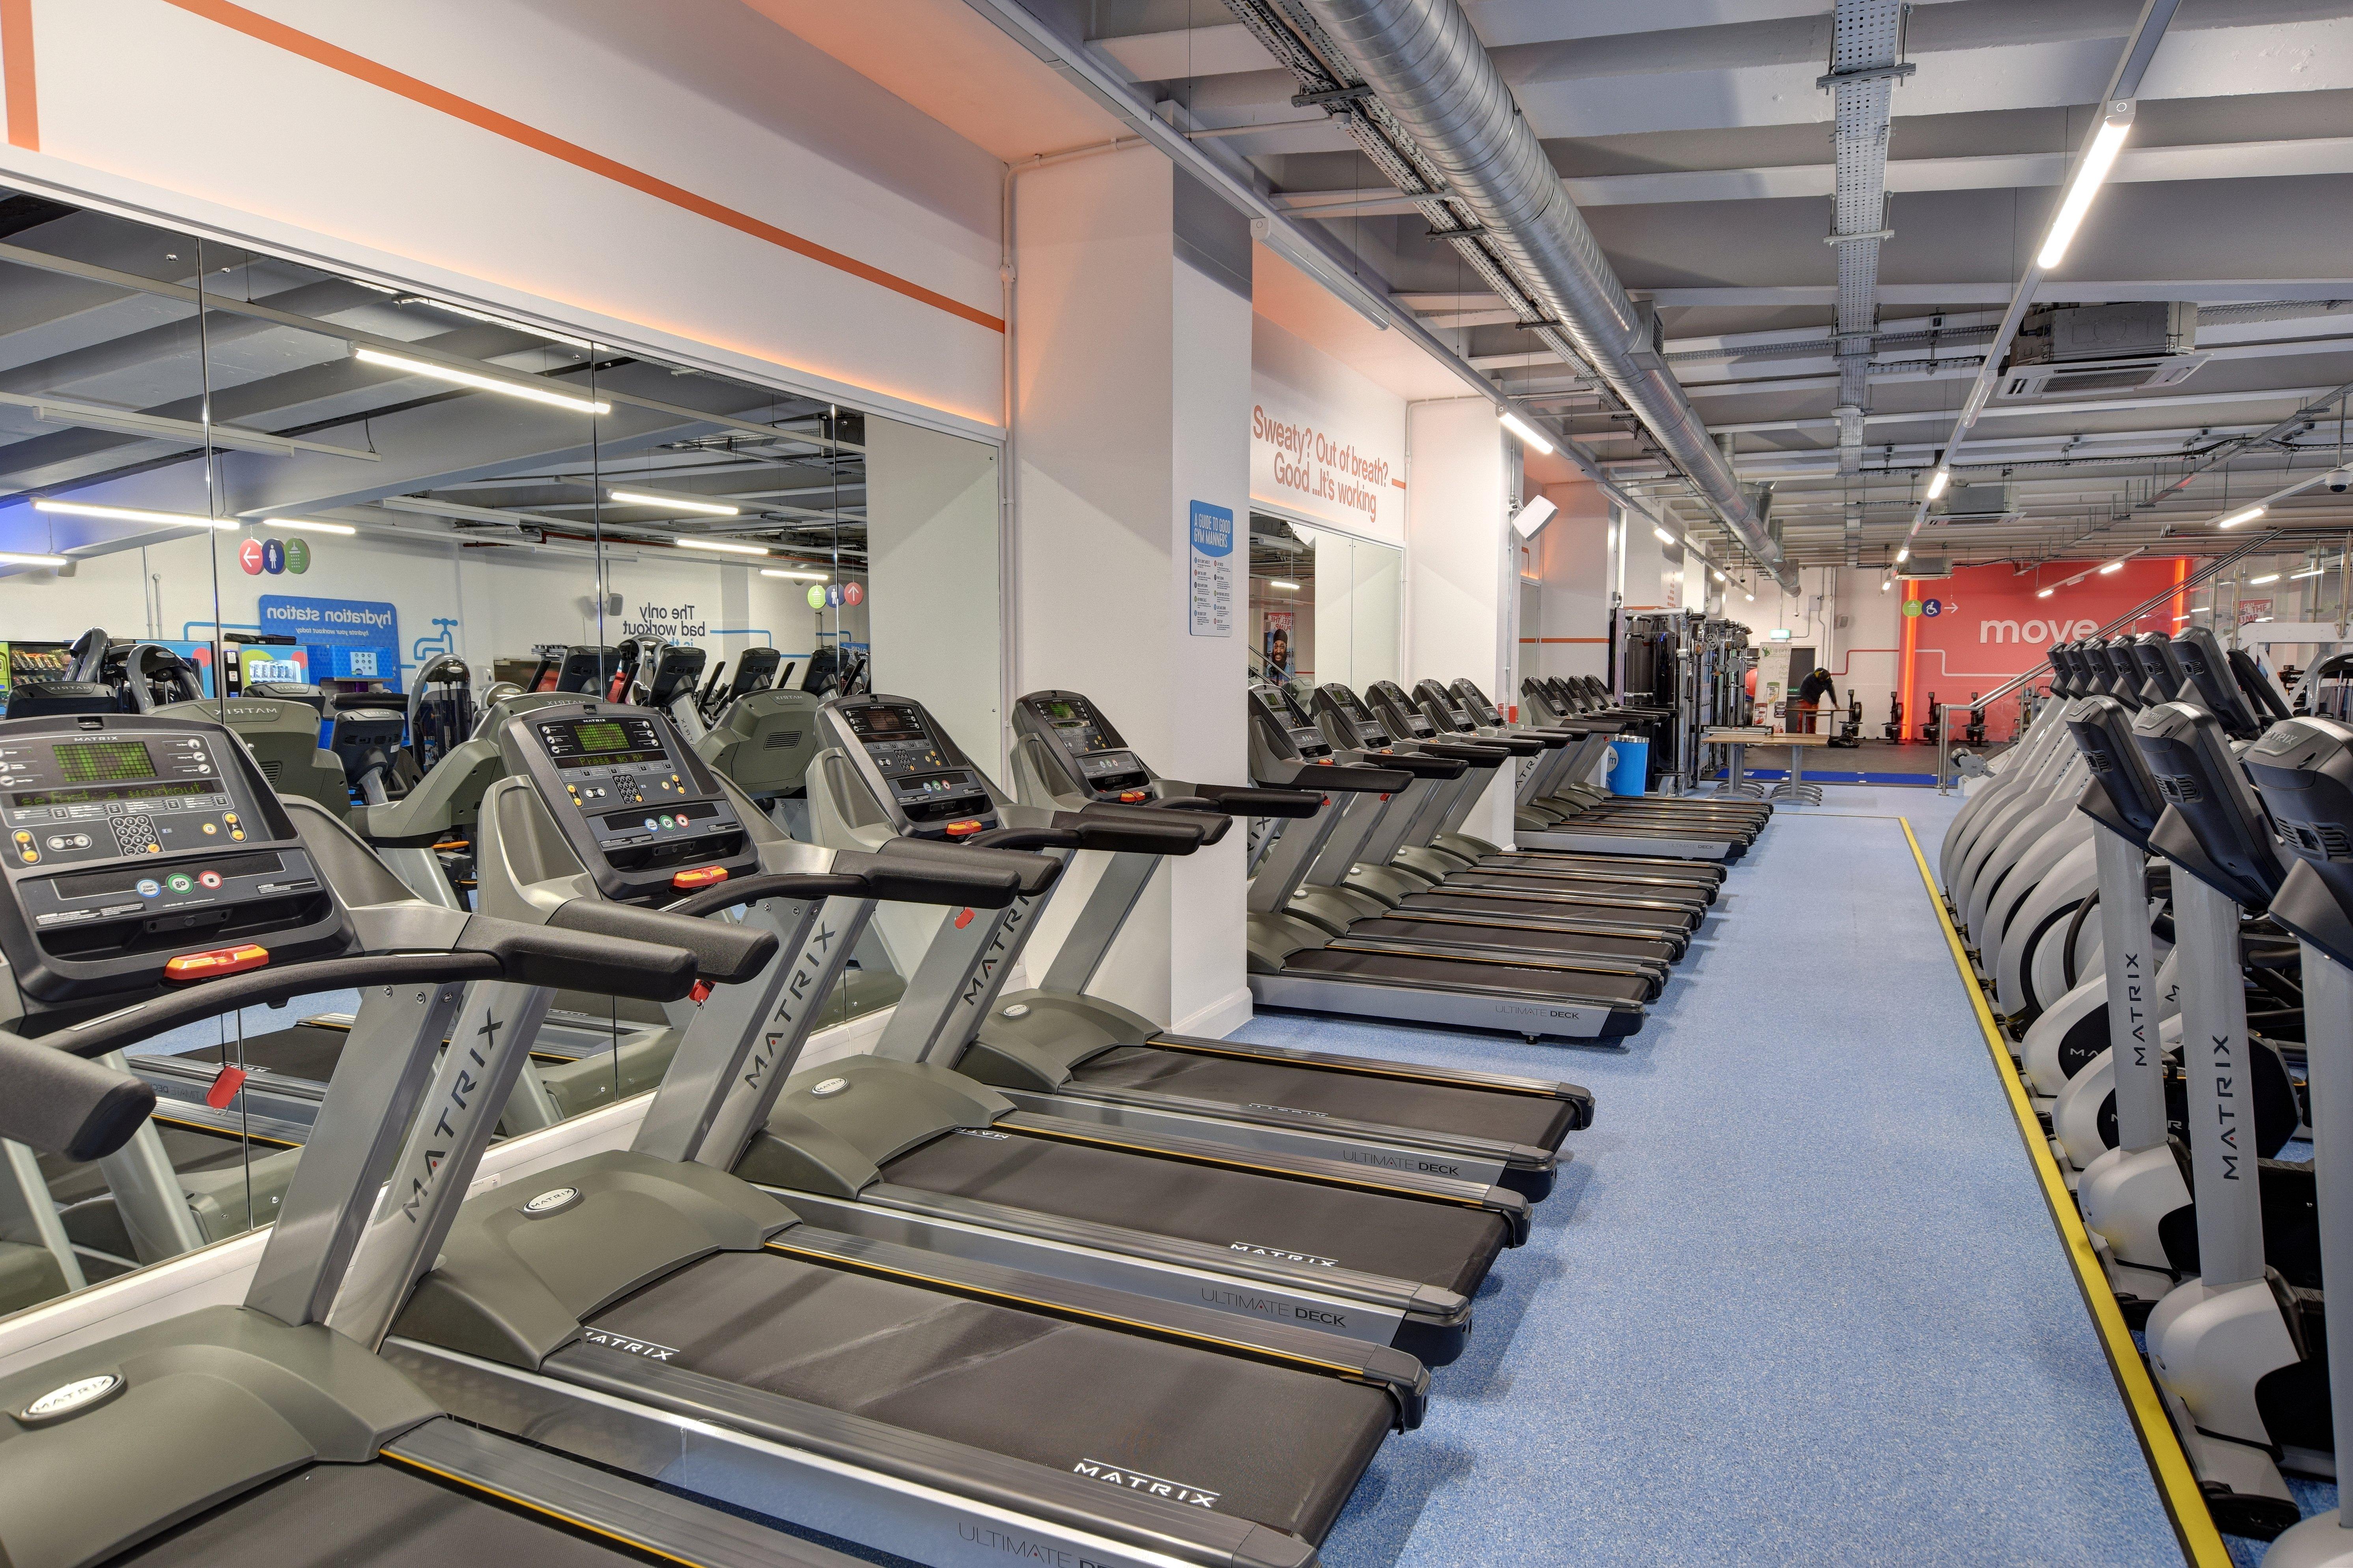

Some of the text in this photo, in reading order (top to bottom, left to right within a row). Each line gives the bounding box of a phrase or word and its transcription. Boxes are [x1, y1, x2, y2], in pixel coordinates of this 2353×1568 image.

[1253, 405, 1388, 487] Sweaty? Out of breath?
[1274, 452, 1309, 493] Good
[1338, 481, 1376, 523] working
[1194, 513, 1231, 534] A GUIDE TO GOOD
[1194, 529, 1227, 548] GYM MANNERS
[1980, 620, 2099, 644] move
[964, 896, 1029, 1005] MATRI
[745, 920, 835, 1090] MATRIX
[1007, 1006, 1026, 1015] MATRIX
[1495, 1005, 1579, 1020] ULTIMATE DECK
[2125, 953, 2147, 1066] MATRIX
[816, 1079, 844, 1091] MATRIX
[402, 1007, 503, 1223] MATRIX
[2212, 1035, 2239, 1180] MATRIX
[955, 1127, 1009, 1139] MATR
[1343, 1150, 1459, 1177] ULTIMATE DECK
[531, 1189, 572, 1208] MATRIX
[1231, 1243, 1335, 1267] MATRIX
[1202, 1288, 1346, 1328] ULTIMATE DECK
[35, 1378, 110, 1411] MATRIX
[1074, 1463, 1214, 1508] MATRIX
[959, 1522, 1072, 1568] ULTIMATE
